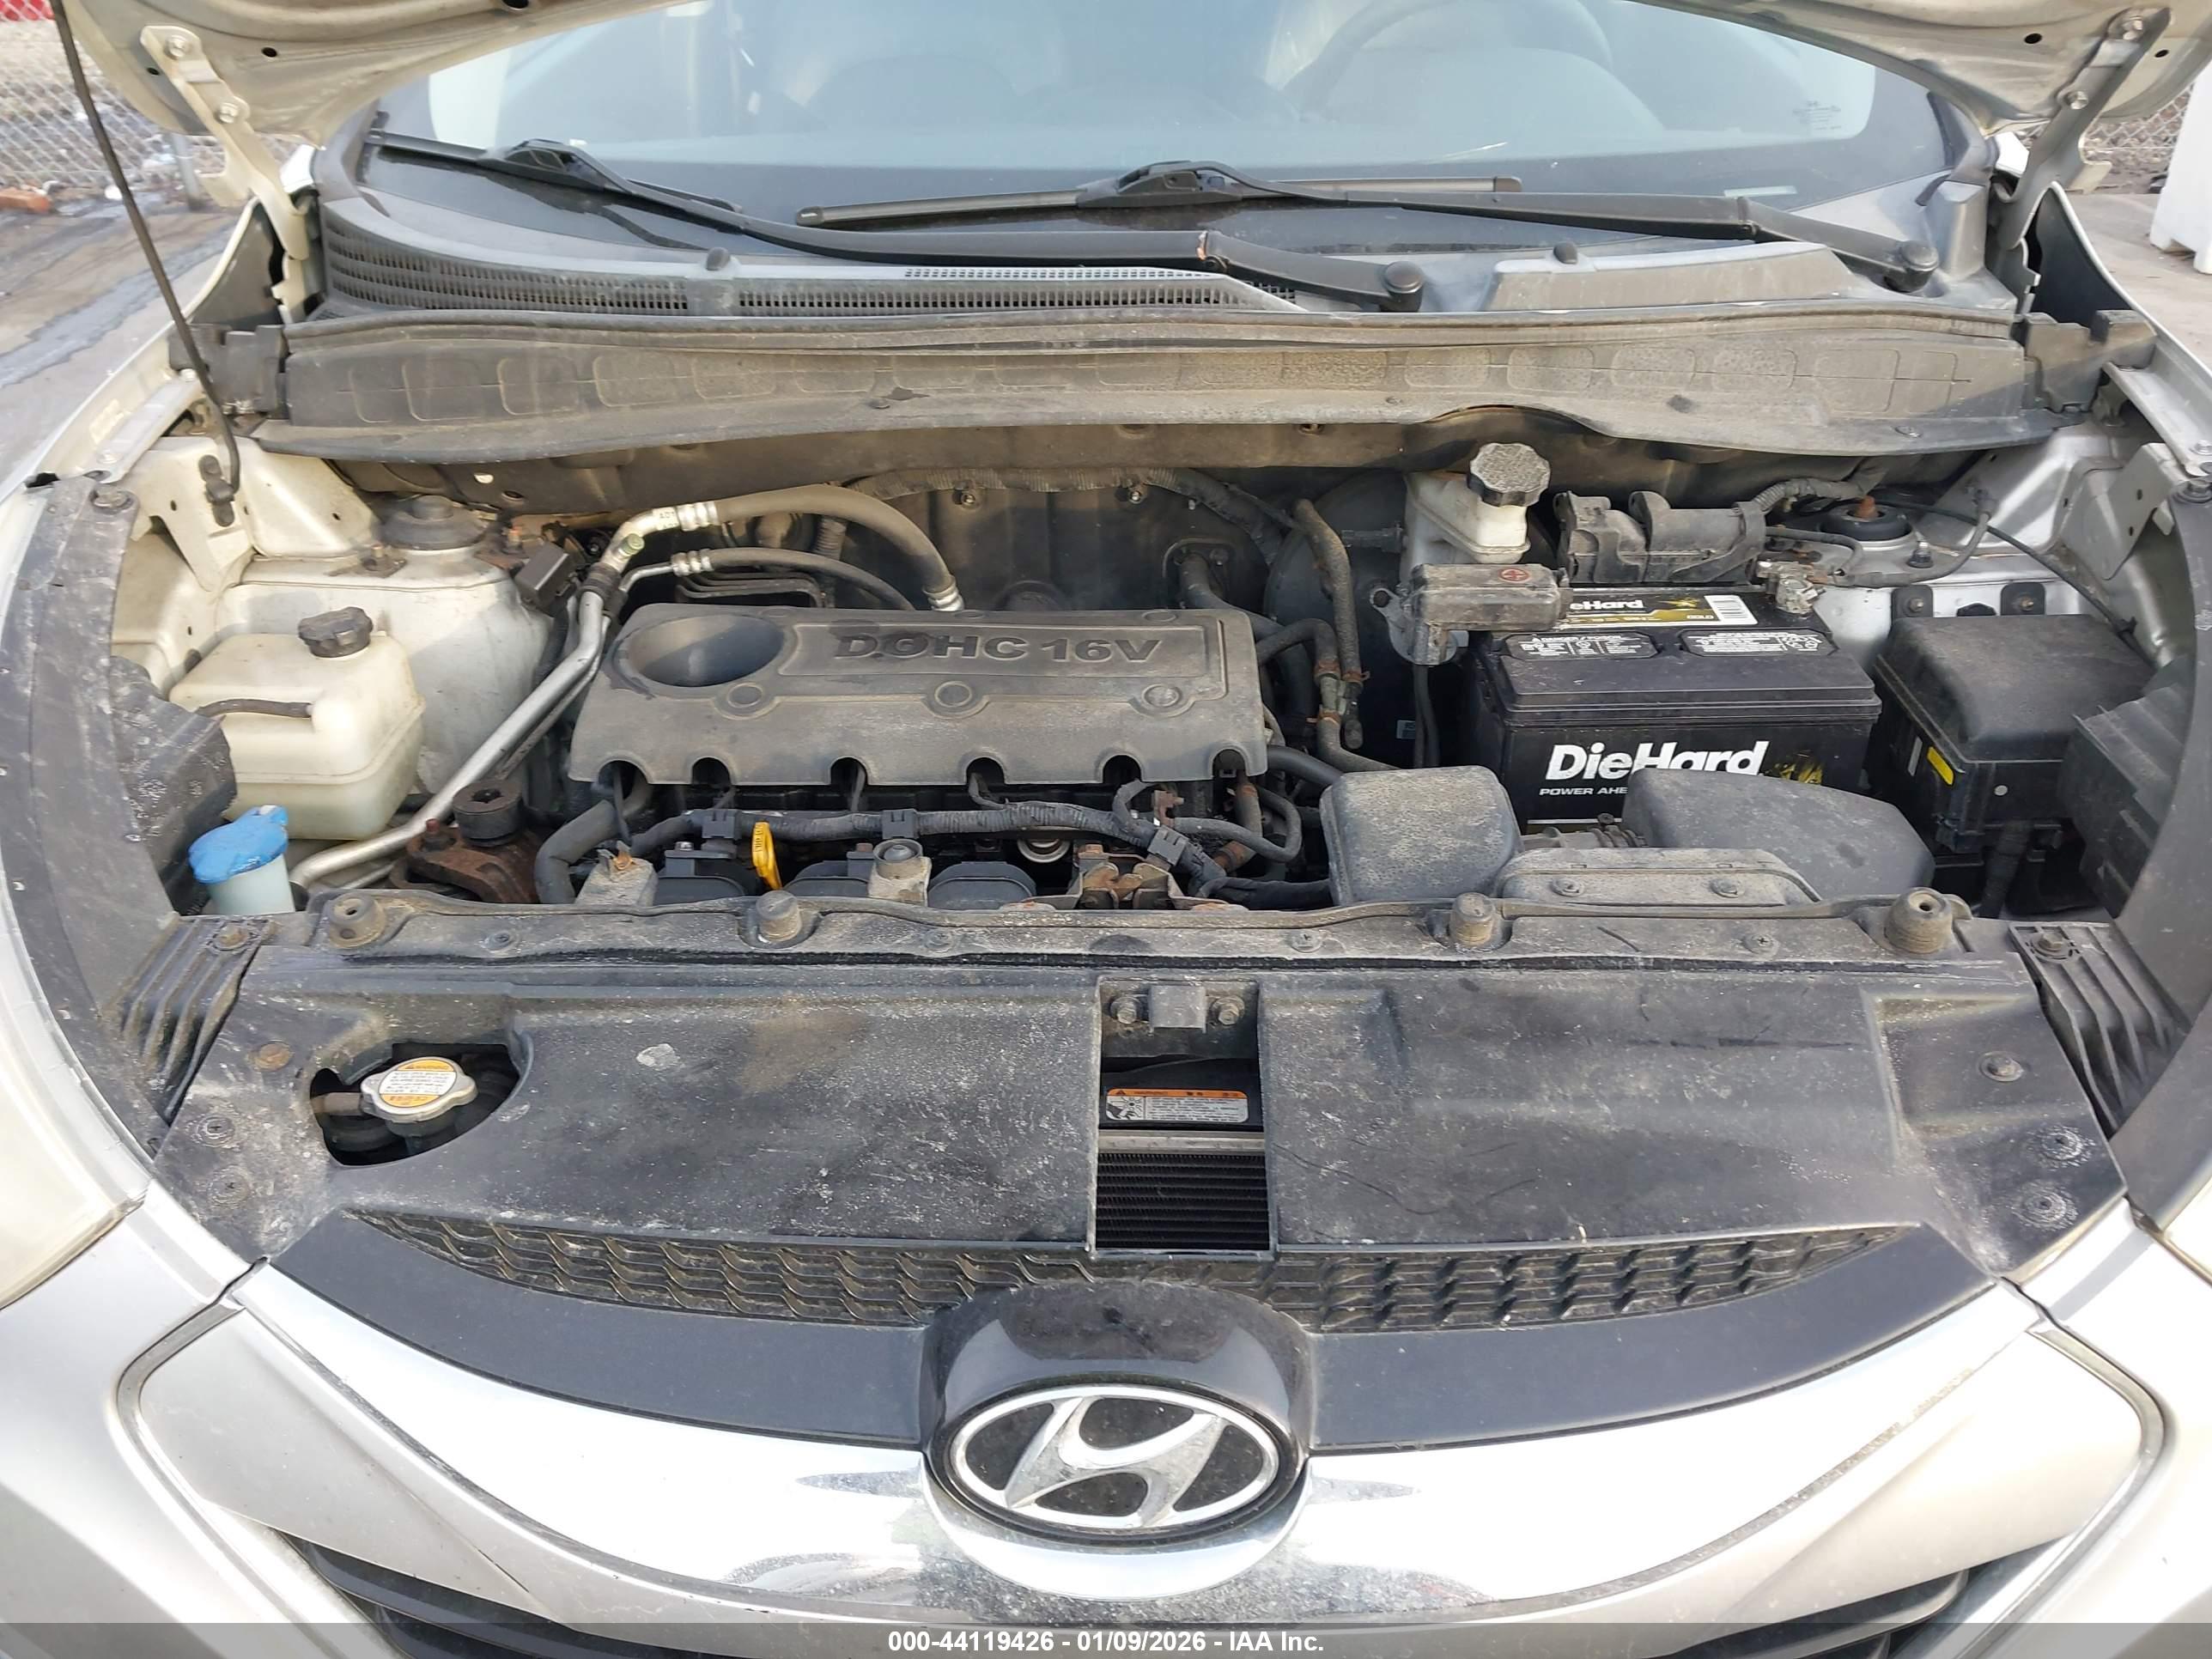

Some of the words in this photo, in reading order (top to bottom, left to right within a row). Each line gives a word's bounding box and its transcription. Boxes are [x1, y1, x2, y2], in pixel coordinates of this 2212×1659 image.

[1570, 599, 1644, 610] eHard
[1041, 637, 1162, 663] 16V
[1545, 740, 1770, 781] DieHard
[1539, 787, 1594, 796] POWER
